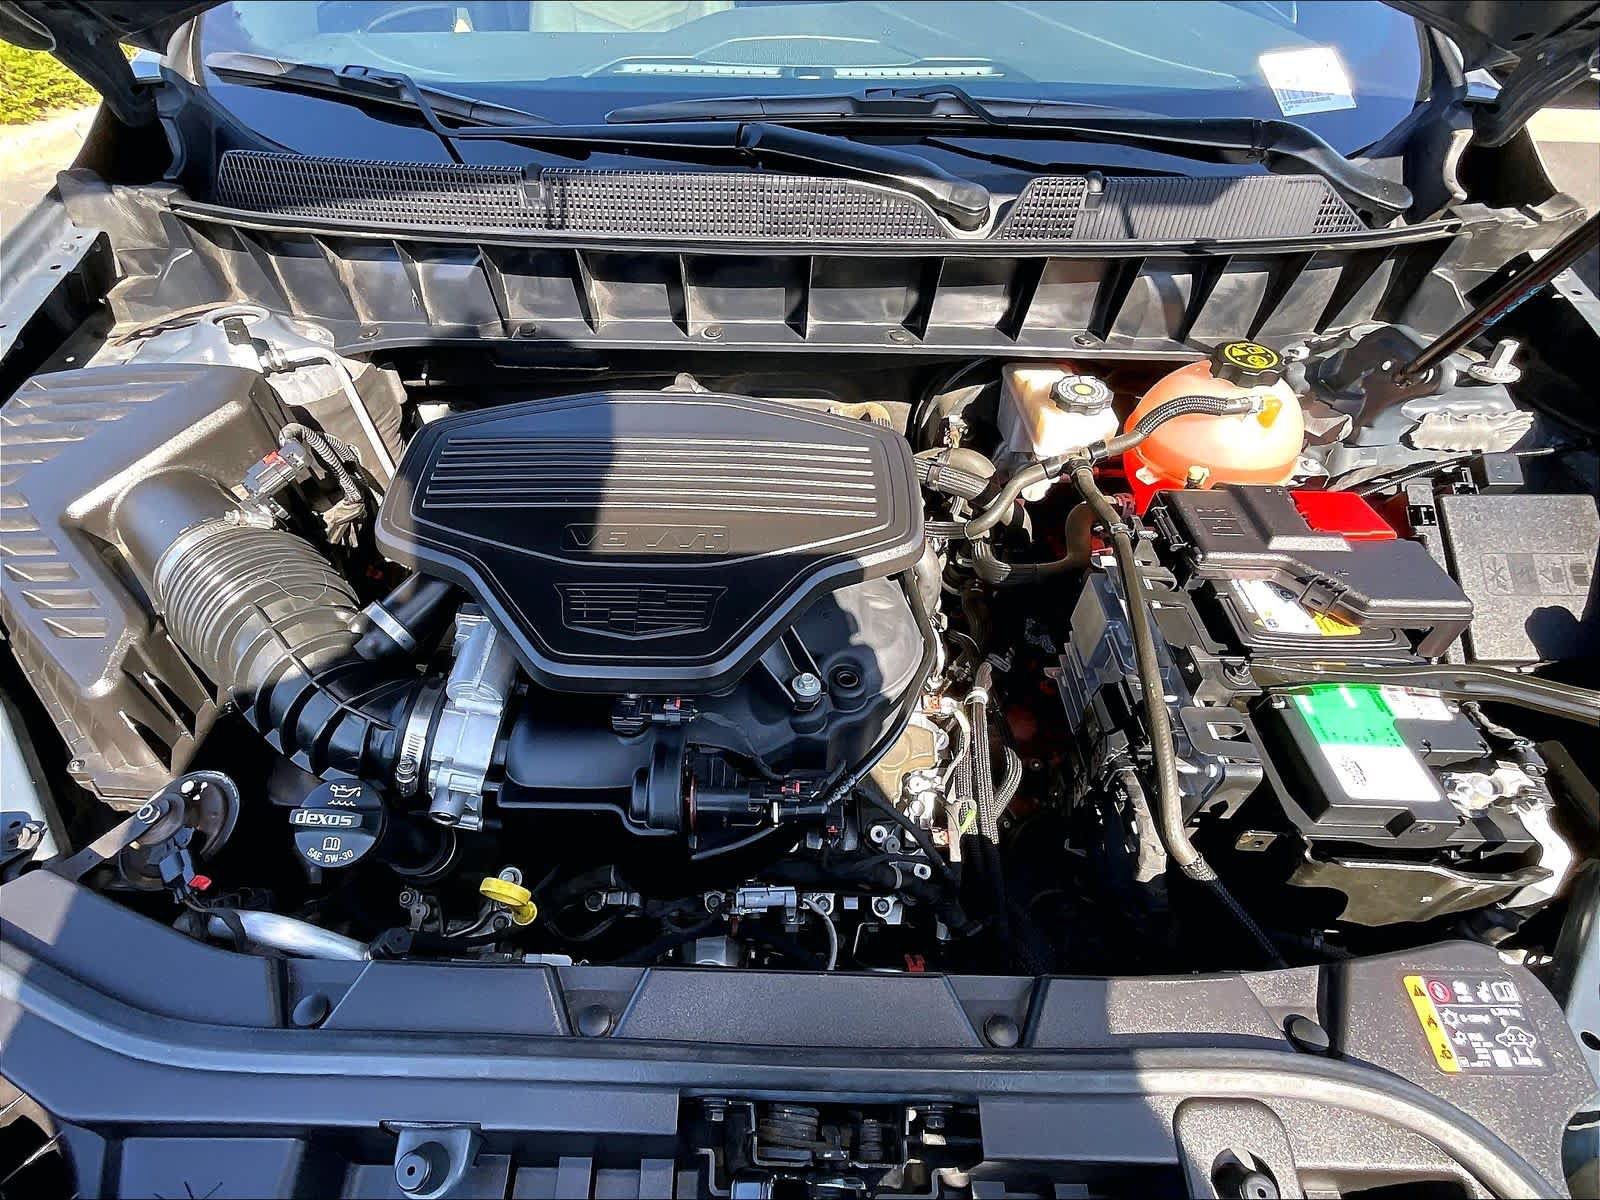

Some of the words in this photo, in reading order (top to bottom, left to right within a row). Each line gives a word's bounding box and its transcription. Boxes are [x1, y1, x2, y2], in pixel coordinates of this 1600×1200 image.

[294, 810, 355, 826] dexos
[306, 847, 323, 861] SAE
[323, 849, 354, 863] 5W-30
